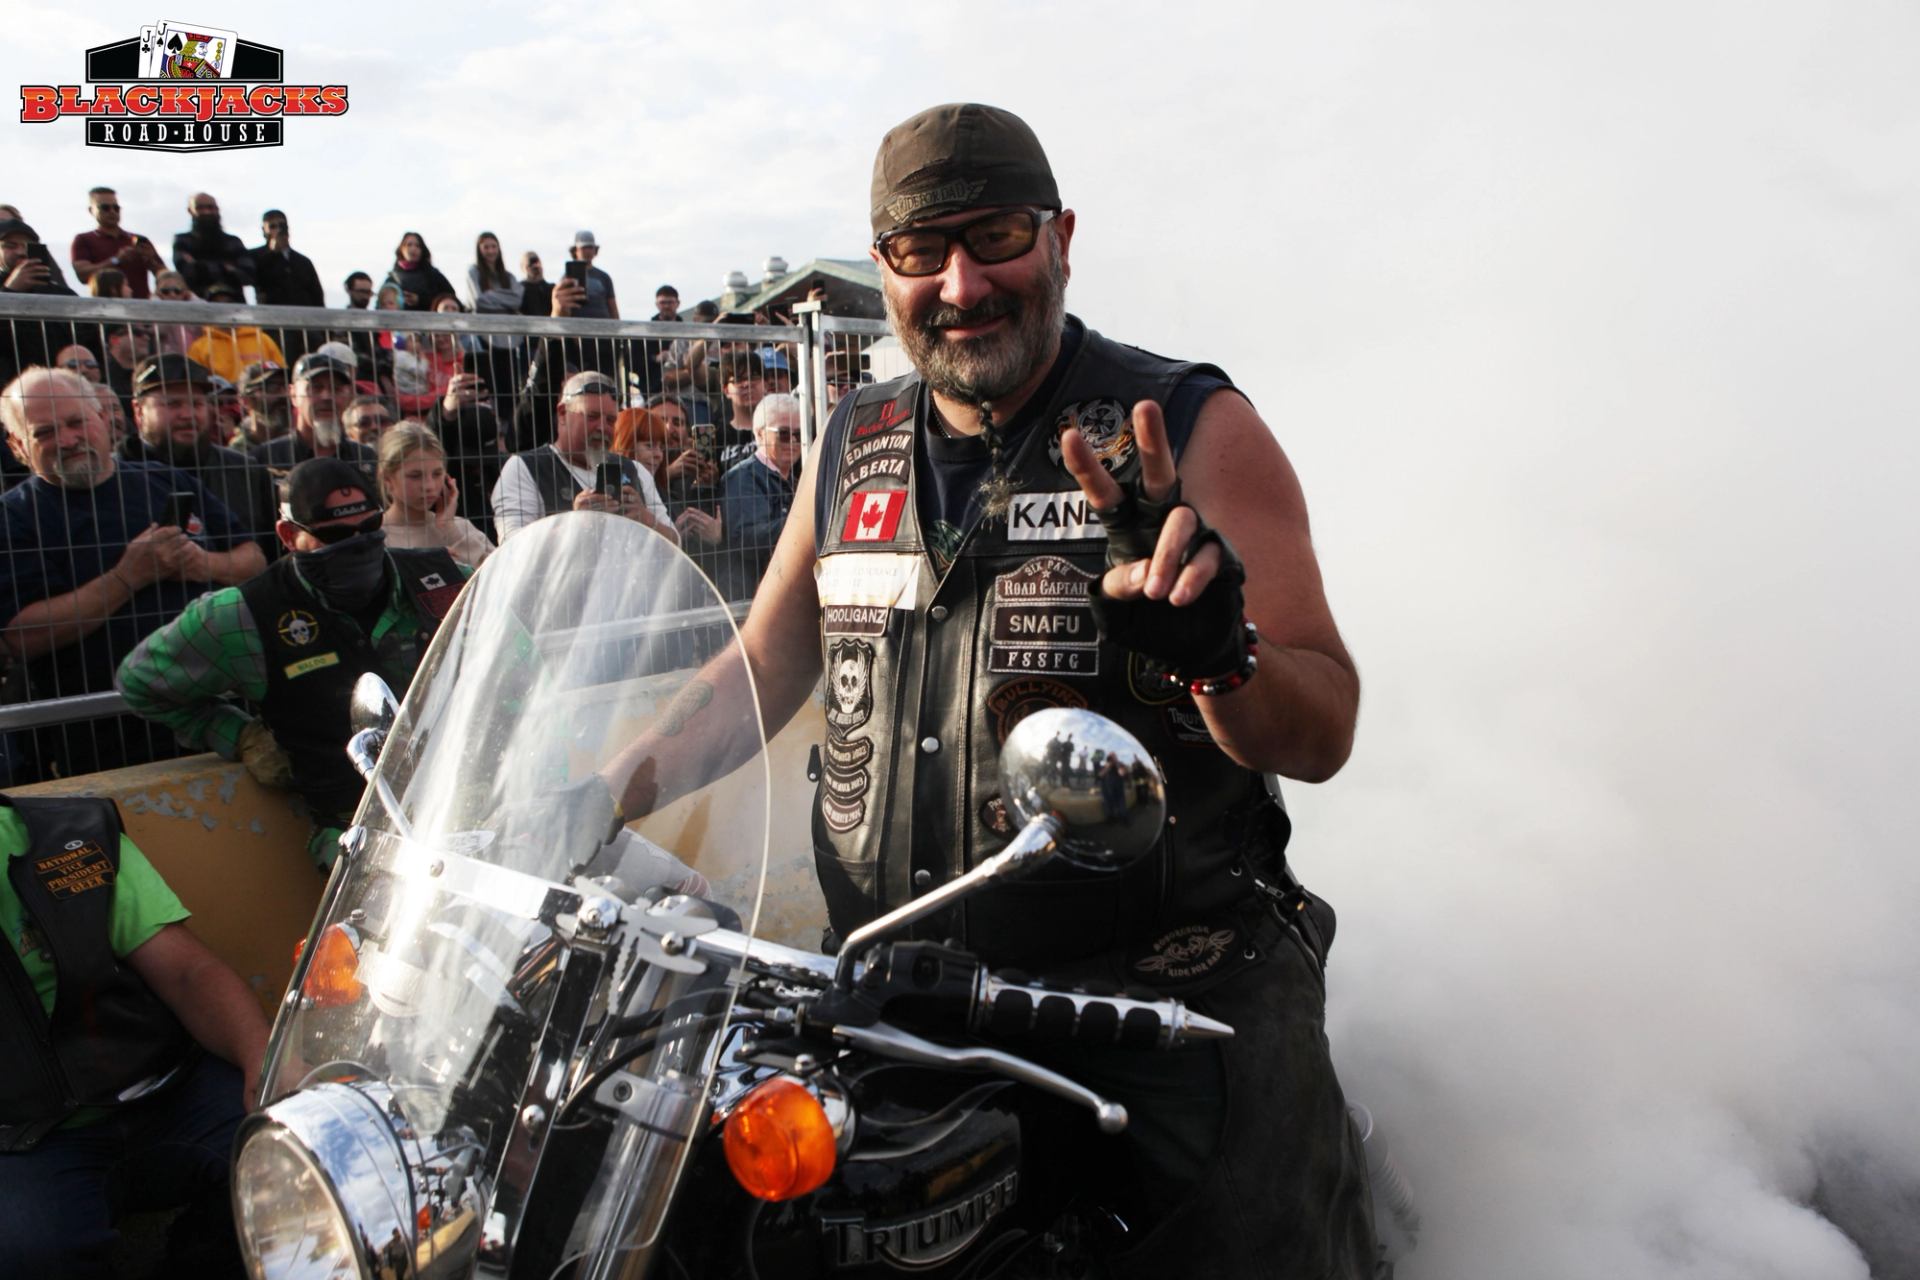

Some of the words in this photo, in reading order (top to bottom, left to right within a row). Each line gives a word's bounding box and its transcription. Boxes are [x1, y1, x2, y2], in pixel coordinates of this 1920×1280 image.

[846, 434, 911, 466] EDMONTON
[843, 459, 905, 491] ALBERTA
[1024, 561, 1042, 576] SIX
[1004, 579, 1036, 596] ROAD
[827, 608, 887, 624] HOOLIGANZ
[1009, 614, 1080, 634] SNAFU
[37, 847, 92, 871] NATIONAL
[58, 861, 86, 875] VICE
[47, 860, 109, 890] PRESIDENT
[821, 1170, 1019, 1270] TRIUMPH
